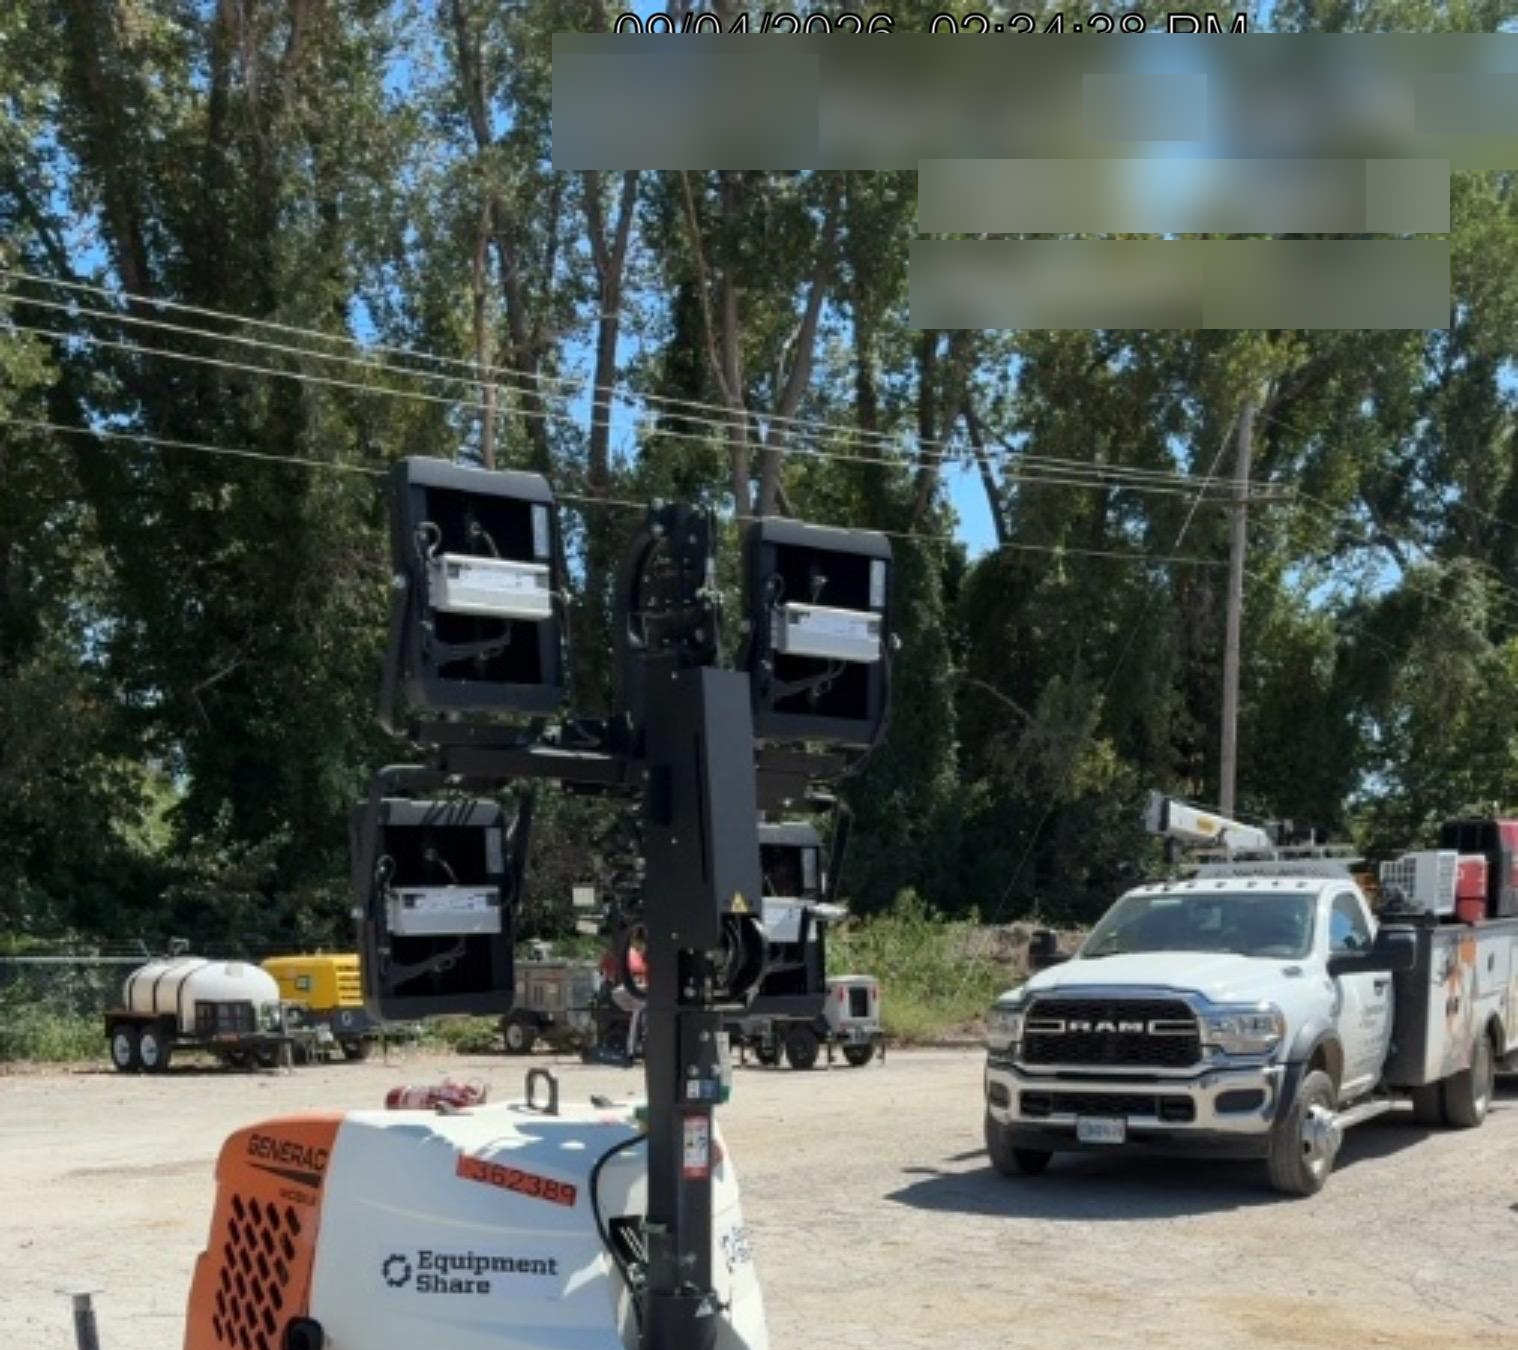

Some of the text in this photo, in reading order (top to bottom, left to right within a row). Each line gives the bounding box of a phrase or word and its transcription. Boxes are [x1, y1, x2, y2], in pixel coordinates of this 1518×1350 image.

[1069, 1020, 1145, 1033] RAM
[247, 1132, 328, 1171] GENERAC
[473, 1159, 577, 1207] 362389
[416, 1249, 559, 1276] Equipment
[416, 1274, 491, 1294] Share
